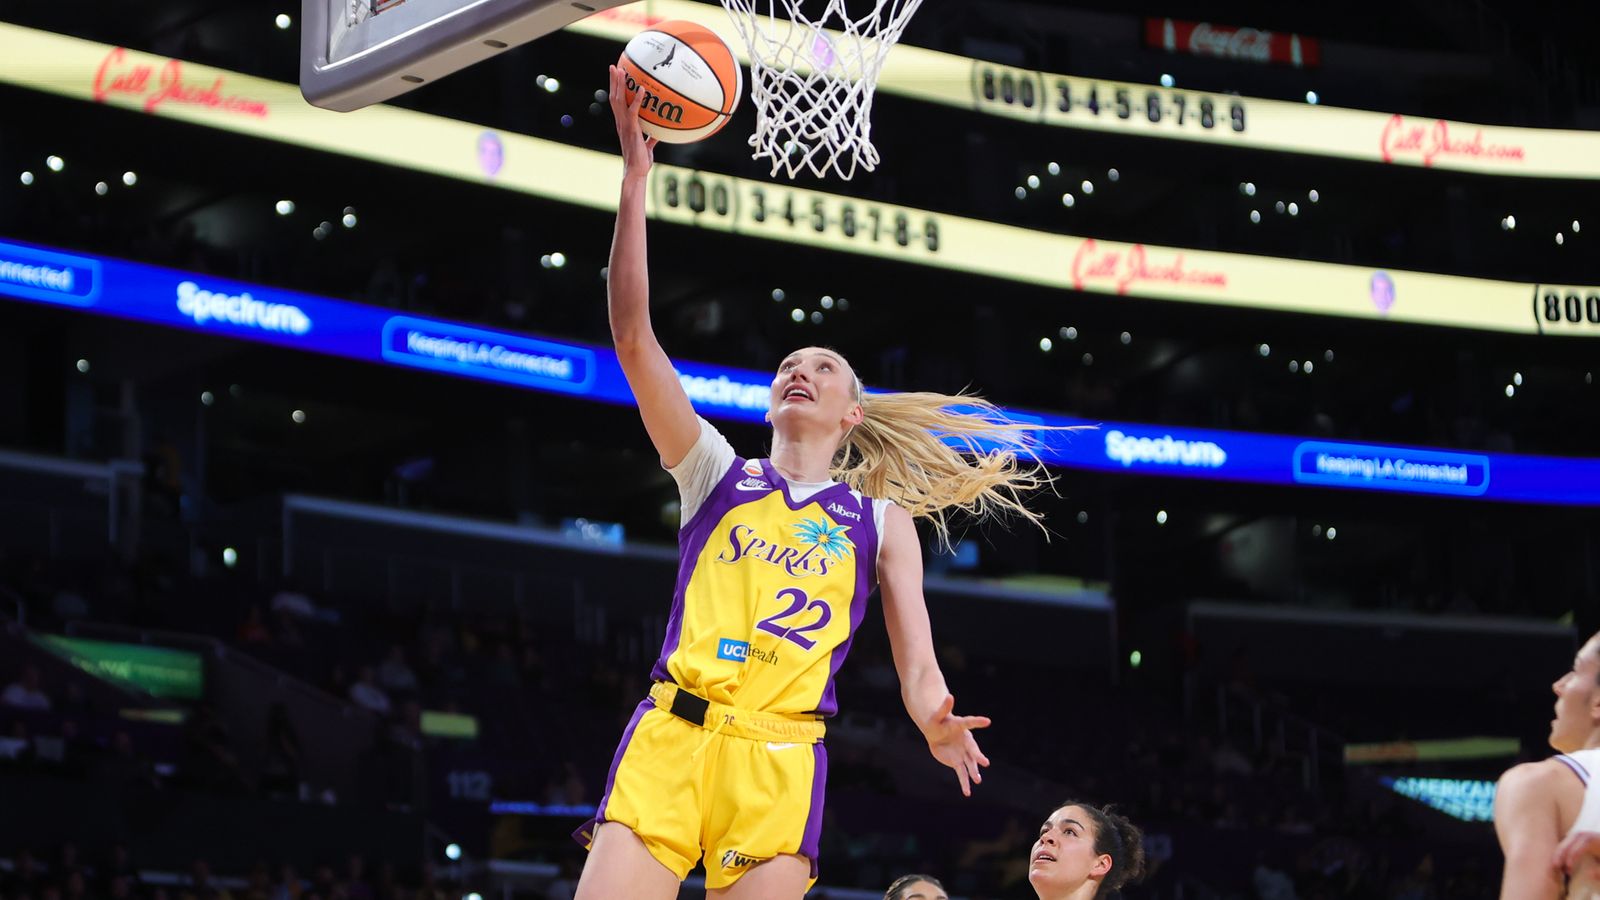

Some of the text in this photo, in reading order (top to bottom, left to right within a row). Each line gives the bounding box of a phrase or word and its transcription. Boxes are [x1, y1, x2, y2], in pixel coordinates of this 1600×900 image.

[624, 70, 683, 123] Wilo
[177, 281, 311, 335] Spectrum
[675, 369, 771, 411] pectrum
[1105, 430, 1226, 467] Spectrum
[827, 502, 862, 523] Albert
[756, 588, 832, 651] 22
